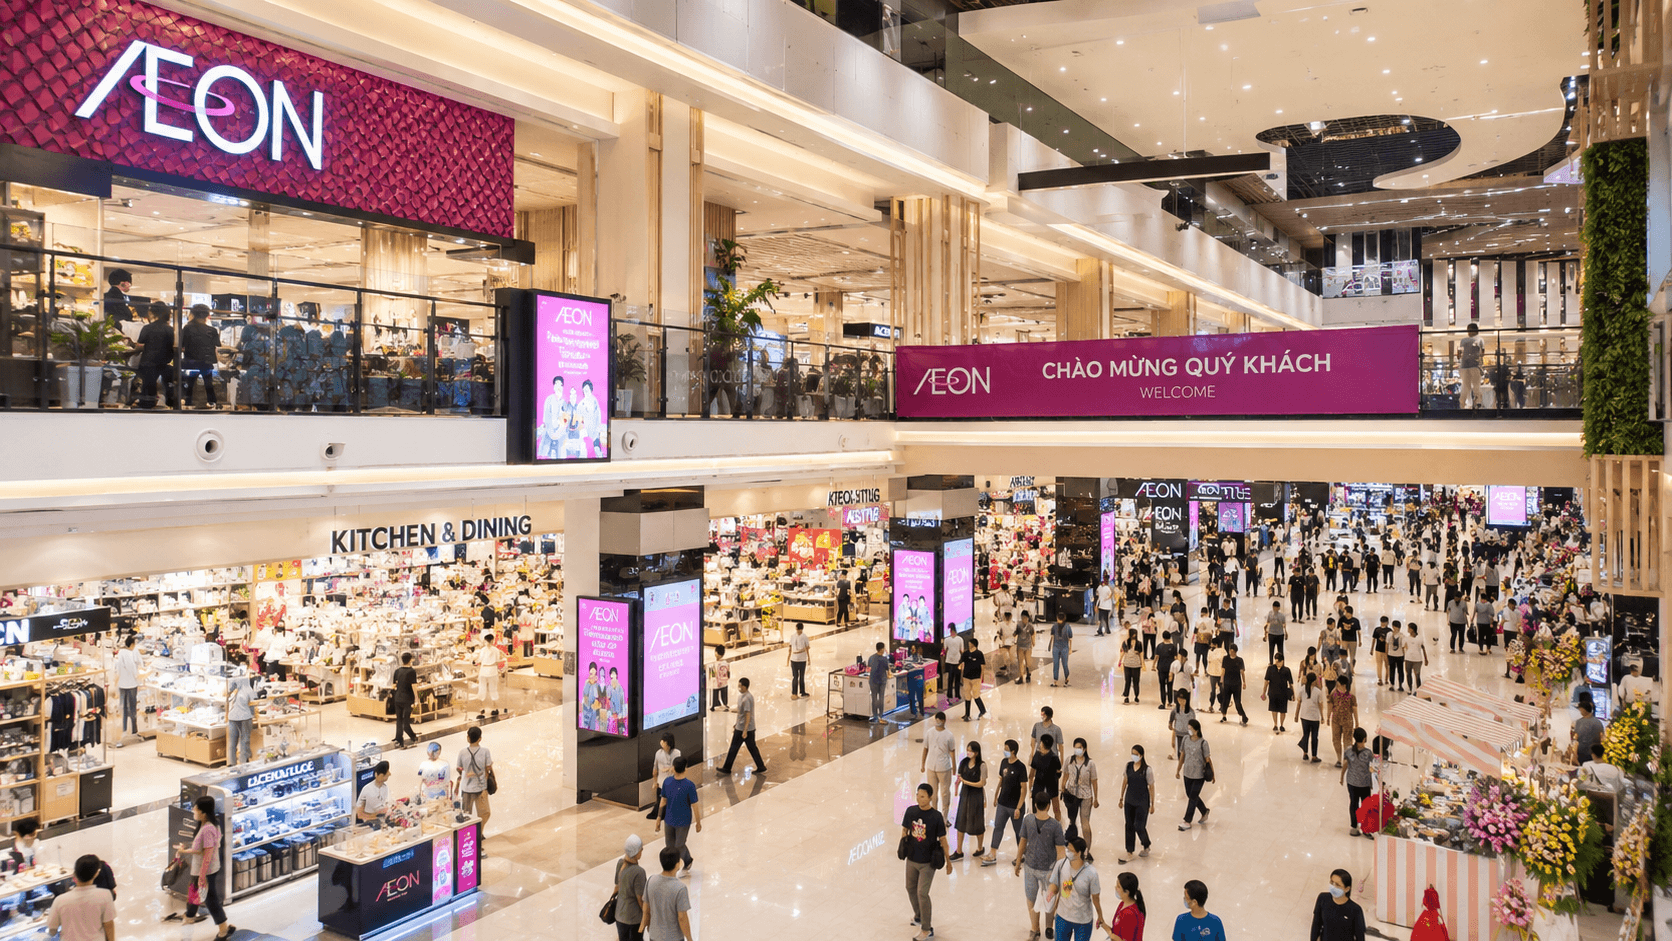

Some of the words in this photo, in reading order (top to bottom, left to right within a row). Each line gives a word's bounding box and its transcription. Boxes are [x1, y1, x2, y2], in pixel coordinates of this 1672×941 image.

[1042, 356, 1103, 380] CHÀO
[1109, 354, 1178, 378] MỪNG
[1185, 351, 1236, 377] QUÝ
[1243, 349, 1331, 374] KHÁCH
[1139, 385, 1216, 399] WELCOME
[330, 523, 436, 554] KITCHEN
[441, 522, 456, 543] &
[460, 515, 532, 542] DINING
